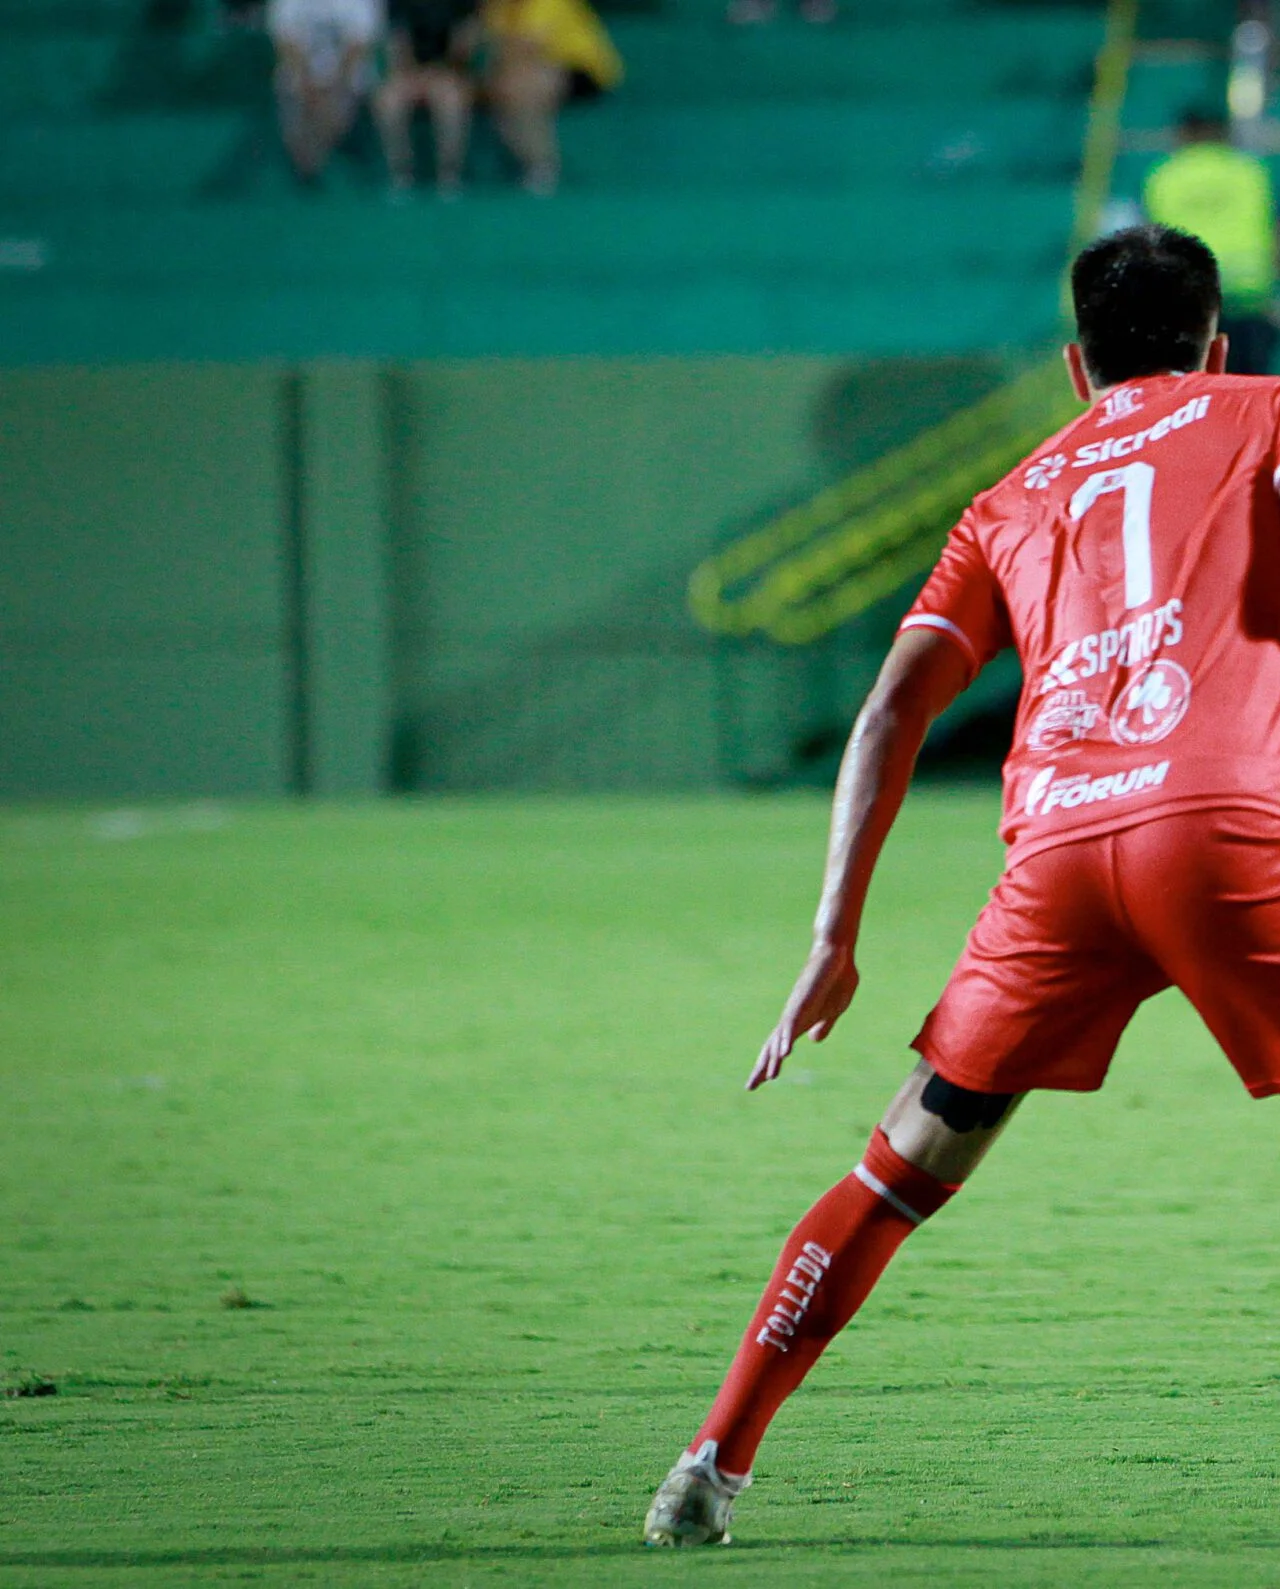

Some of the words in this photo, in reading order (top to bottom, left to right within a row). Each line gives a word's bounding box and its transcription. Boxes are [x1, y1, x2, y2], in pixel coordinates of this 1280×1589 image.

[1071, 394, 1213, 469] Sicredi
[1068, 461, 1156, 610] 7
[1040, 760, 1171, 816] FORUM
[756, 1240, 833, 1354] TOLLEDO
